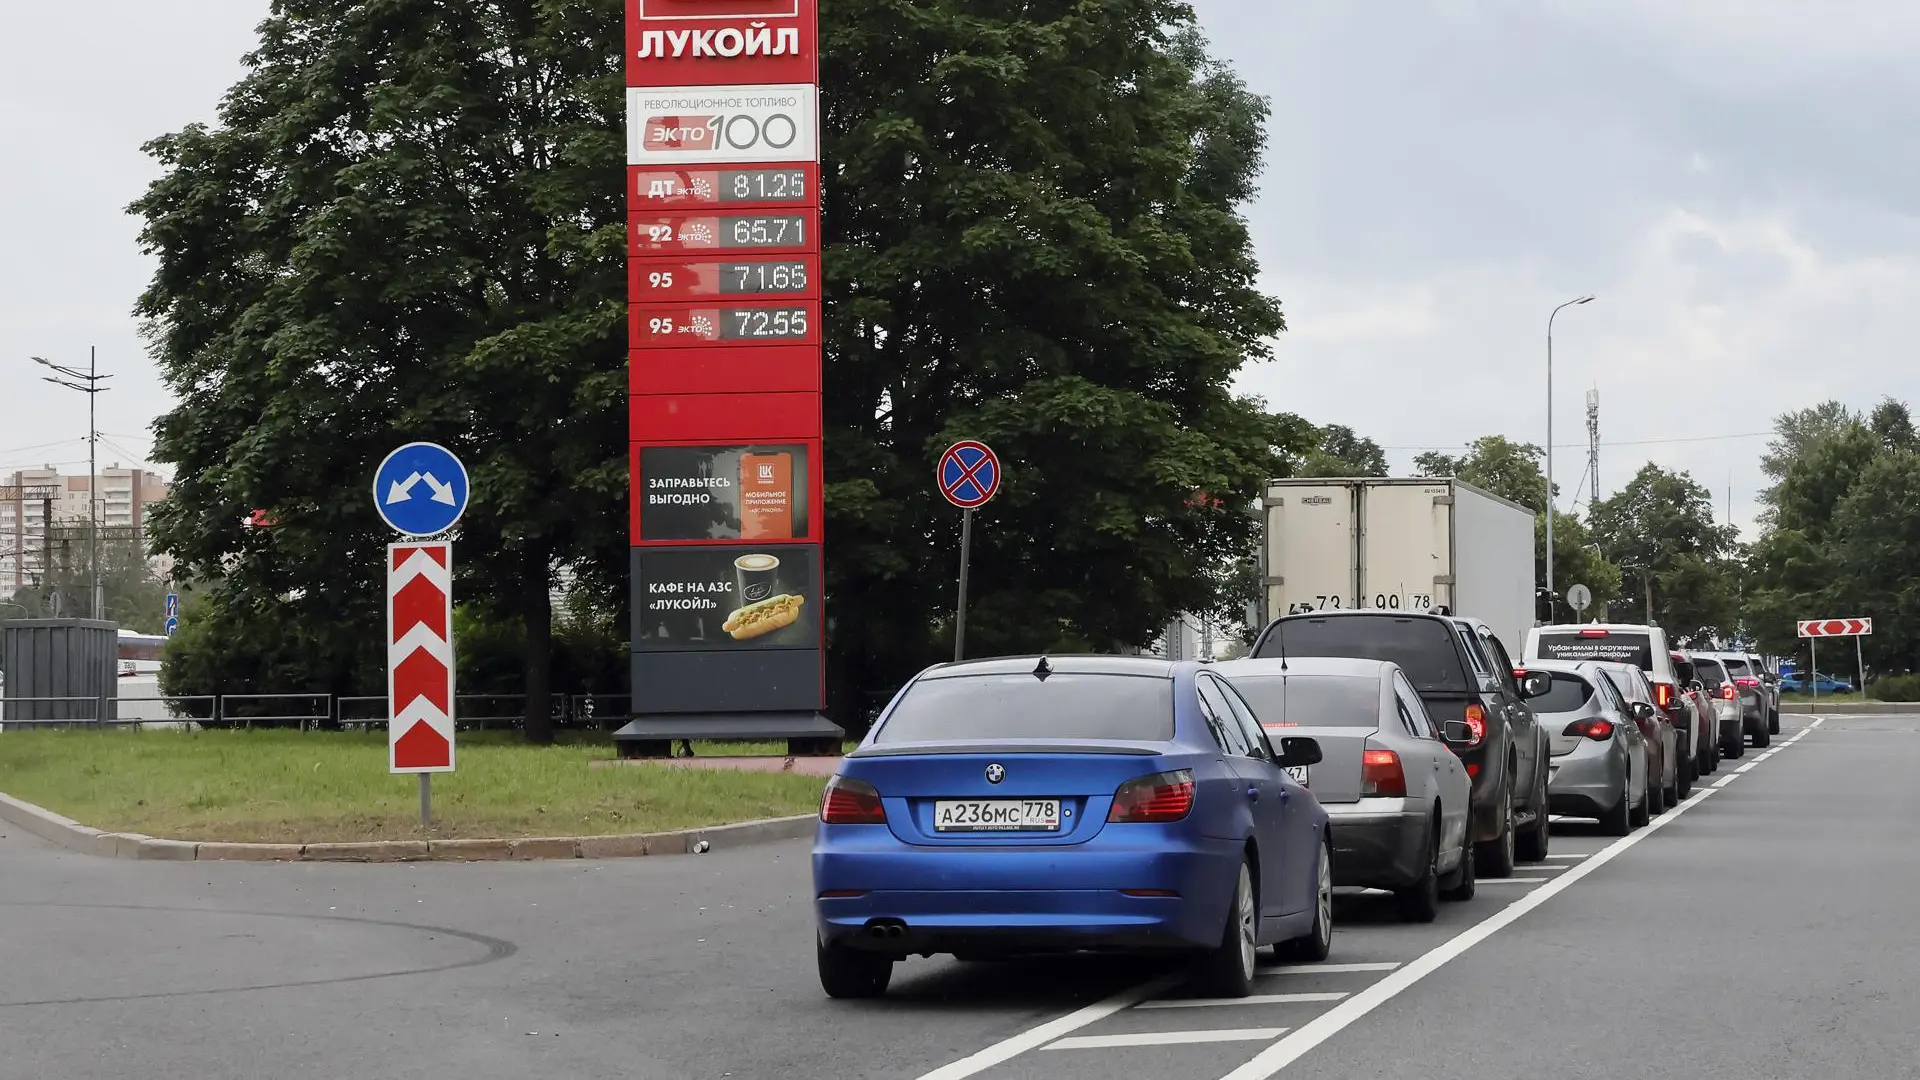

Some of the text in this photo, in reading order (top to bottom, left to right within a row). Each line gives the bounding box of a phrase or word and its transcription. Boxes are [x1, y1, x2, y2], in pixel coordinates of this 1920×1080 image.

[637, 21, 799, 58] ЛУКОЙЛ
[644, 97, 797, 111] РЕВОЛЮЦИОННОЕ ТОПЛИВО
[652, 113, 797, 150] ЭКТО 100
[648, 172, 804, 199] ДТ ЭКТО 81.25
[648, 218, 803, 243] 92 ЭКТО 65.71
[649, 265, 807, 290] 95 71.65
[649, 318, 673, 334] 95
[735, 310, 807, 336] 72.55
[649, 477, 731, 489] ЗАПРАВЬТЕСЬ
[649, 493, 710, 506] ВЫГОДНО
[649, 581, 733, 593] КАФЕ НА АЗС
[649, 597, 717, 610] «ЛУКОЙЛ»
[1413, 595, 1430, 609] 78
[1547, 644, 1594, 652] Урбан-виллы
[1556, 650, 1598, 658] уникальной
[941, 802, 1054, 824] А236МС 778
